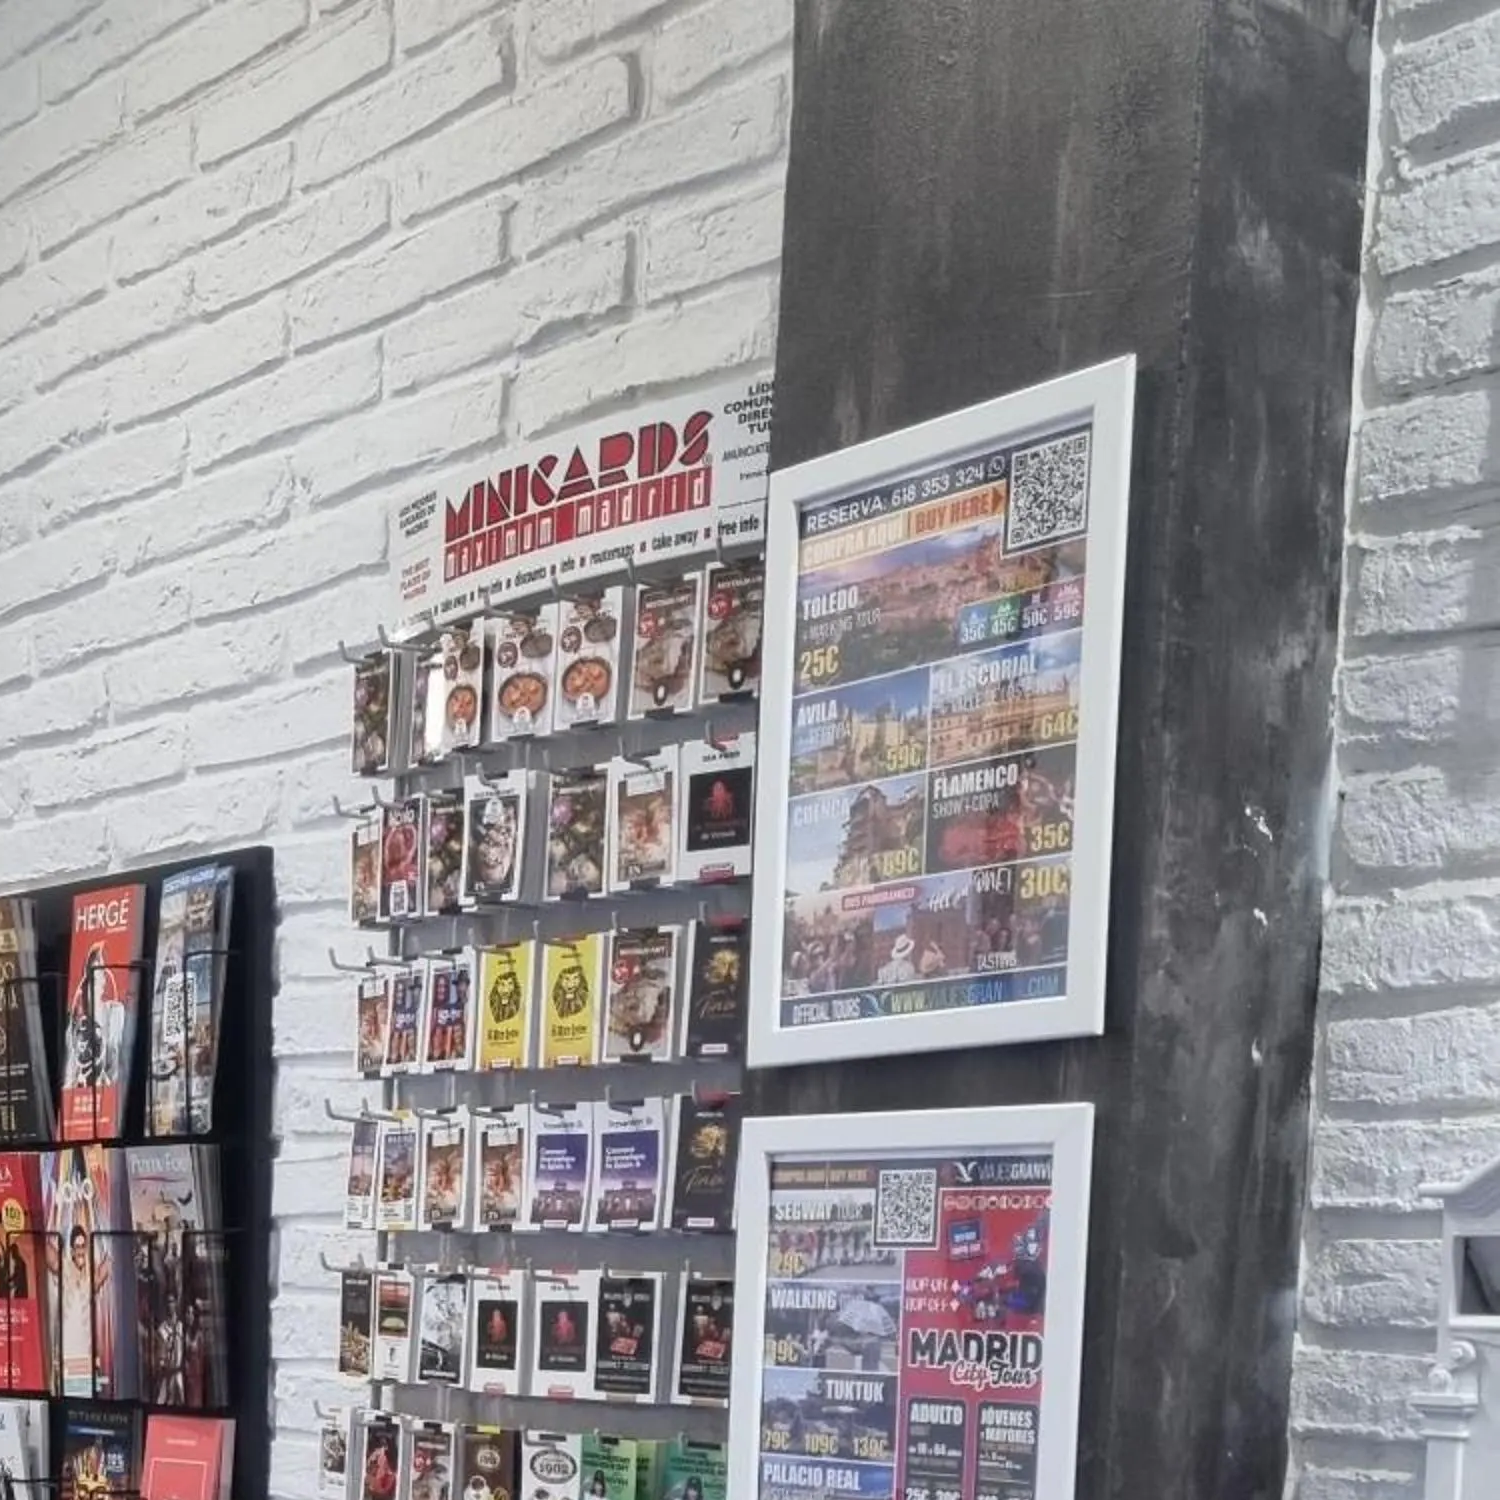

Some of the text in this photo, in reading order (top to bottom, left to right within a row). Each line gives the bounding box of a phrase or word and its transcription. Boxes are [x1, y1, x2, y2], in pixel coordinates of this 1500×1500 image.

[445, 409, 714, 543] MINICARDS
[891, 484, 917, 507] 618
[921, 474, 950, 497] 353
[954, 463, 986, 488] 324
[446, 472, 708, 581] maximum madrid
[740, 514, 760, 534] info
[802, 586, 858, 621] TOLEDO
[801, 645, 839, 680] 25€
[933, 763, 1019, 801] FLAMENCO
[1031, 821, 1070, 851] 35€
[1021, 865, 1071, 899] 30€
[75, 894, 131, 933] HERGÉ
[775, 1201, 834, 1222] SEGWAY
[771, 1288, 837, 1310] WALKING
[908, 1329, 1044, 1370] MADRID
[953, 1361, 1037, 1388] City Tour
[909, 1402, 963, 1427] ADULTO
[981, 1404, 1033, 1429] JÓVENES
[985, 1427, 1036, 1446] MAYORES
[763, 1461, 861, 1493] PALACIO REAL
